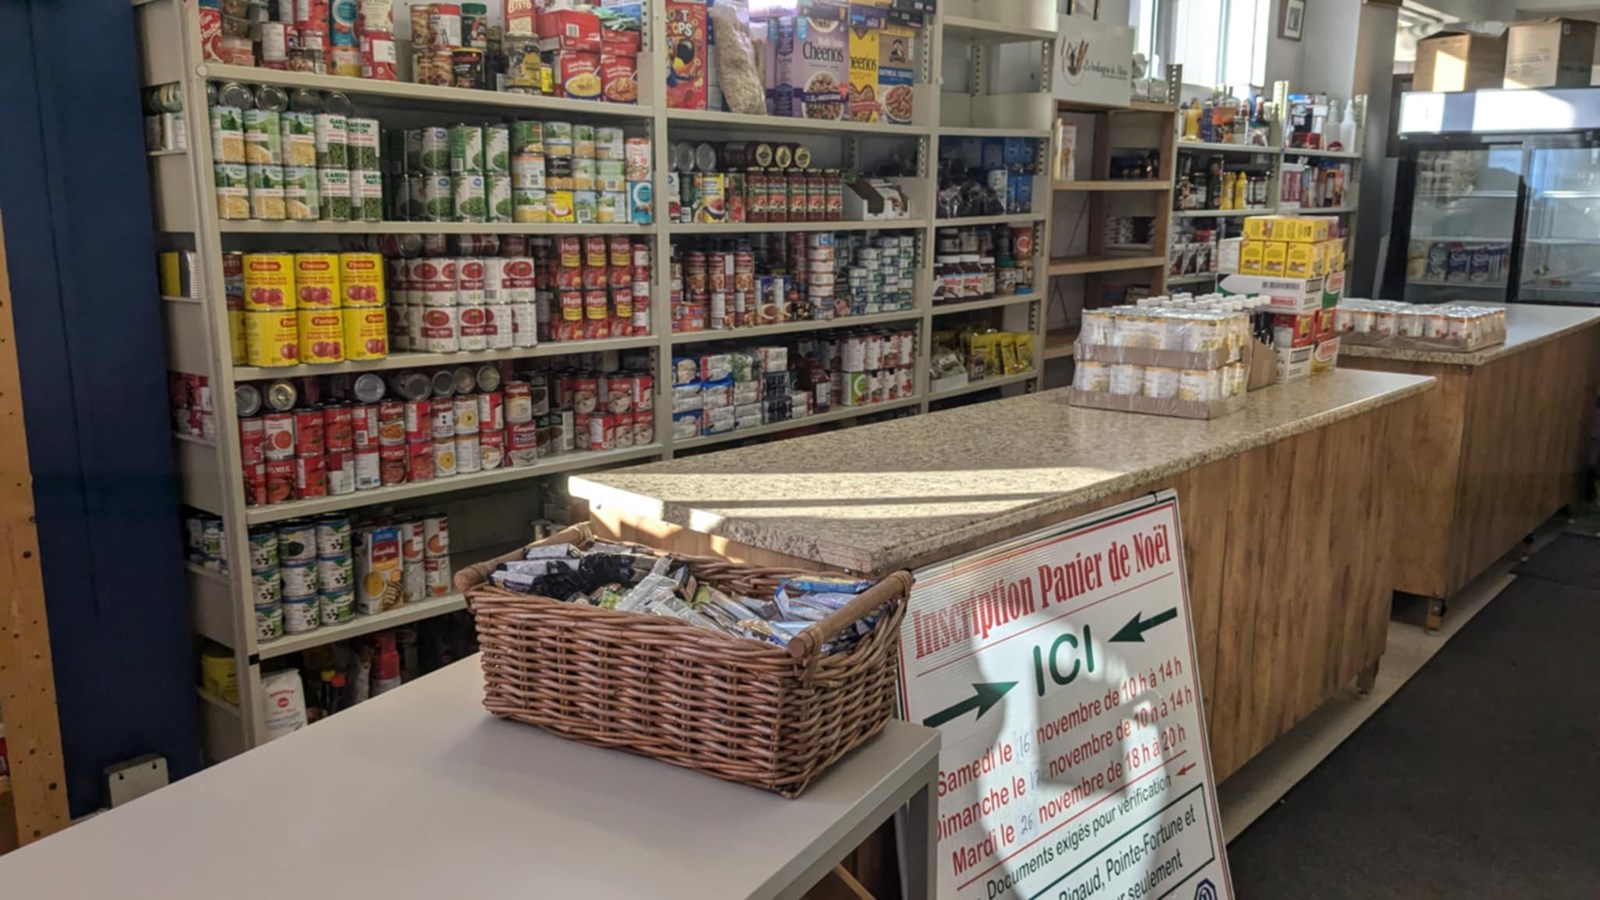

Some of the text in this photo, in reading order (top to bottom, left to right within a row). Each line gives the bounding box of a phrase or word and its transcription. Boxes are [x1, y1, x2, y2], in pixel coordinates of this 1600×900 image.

[802, 41, 844, 64] Cheerios
[850, 56, 877, 72] eerios
[911, 523, 1172, 659] Inscription Panier de Noël
[1033, 624, 1095, 697] ICI
[937, 746, 995, 797] Samedi
[998, 741, 1012, 765] le
[1036, 702, 1102, 745] novembre
[1104, 688, 1120, 711] de
[1121, 677, 1137, 700] 10
[1138, 672, 1147, 692] h
[1149, 668, 1157, 688] à
[1159, 659, 1173, 682] 14
[1173, 656, 1182, 676] h
[1012, 775, 1026, 799] le
[1049, 733, 1113, 778] novembre
[1116, 718, 1131, 741] de
[1133, 707, 1149, 731] 10
[1150, 703, 1159, 723] h
[1169, 688, 1184, 711] 14
[1184, 685, 1193, 704] h
[952, 723, 1186, 877] Mardi le 26 novembre de 18 h à 20 h
[986, 774, 1172, 900] Documents exigés pour vérification
[1105, 816, 1184, 882] Pointe-Fortune
[1184, 803, 1196, 826] et
[1128, 848, 1183, 900] seulement
